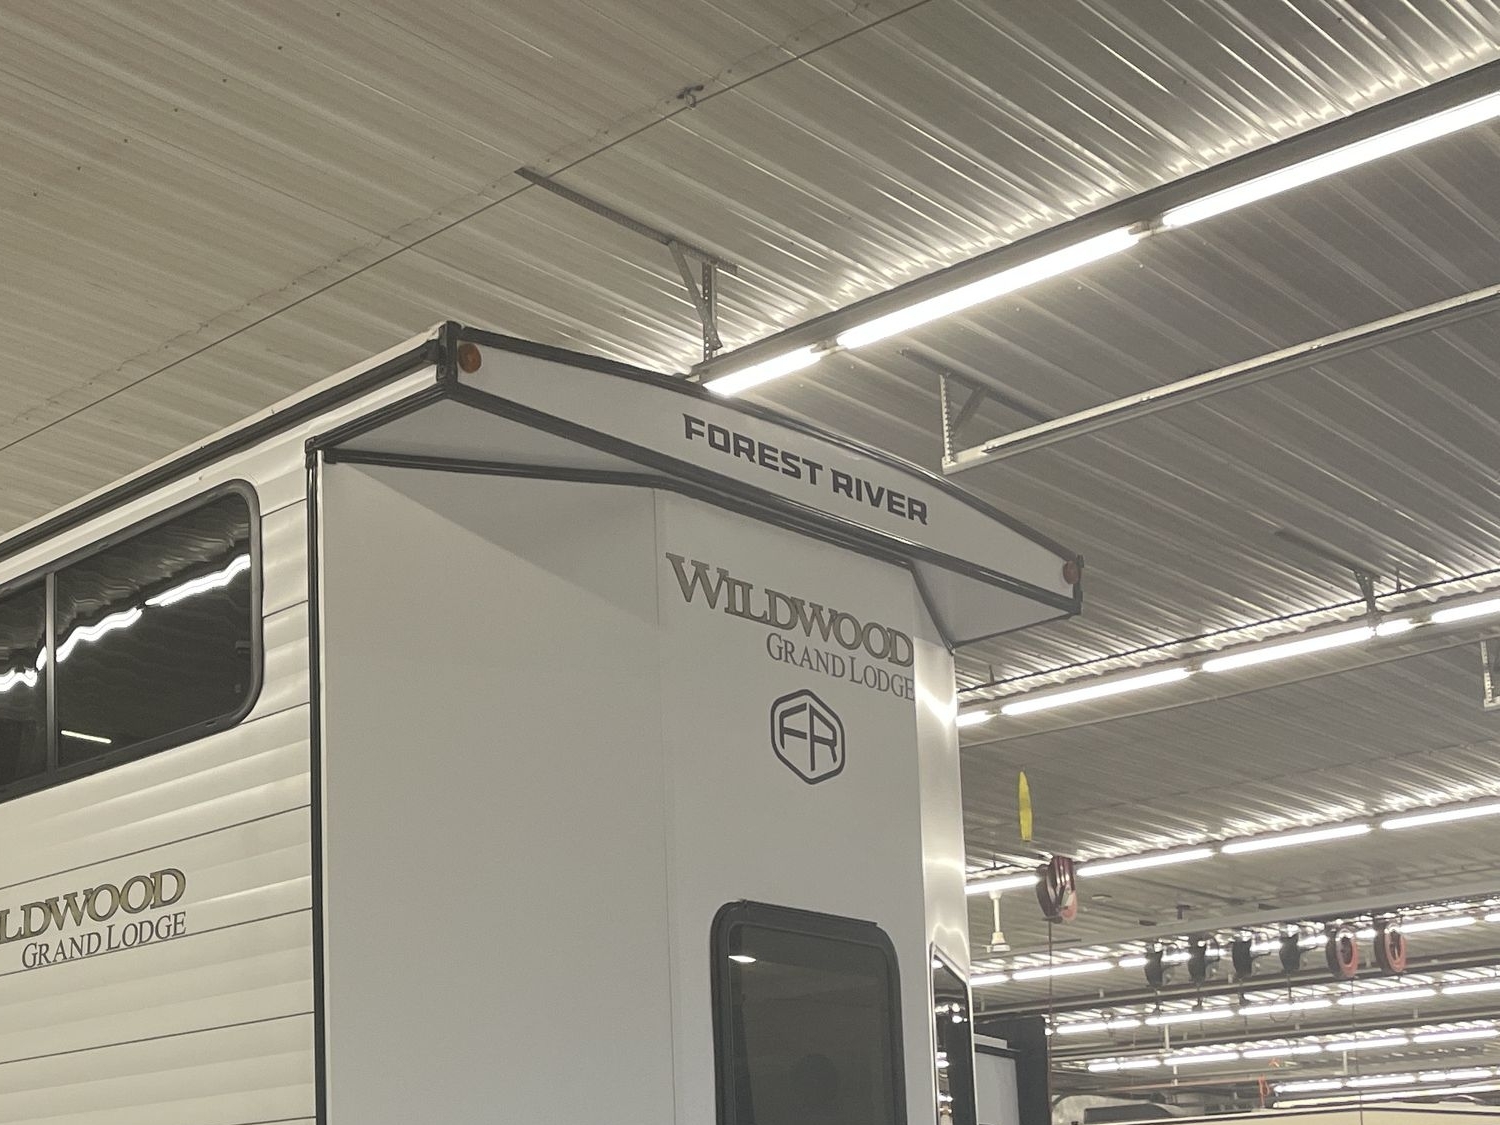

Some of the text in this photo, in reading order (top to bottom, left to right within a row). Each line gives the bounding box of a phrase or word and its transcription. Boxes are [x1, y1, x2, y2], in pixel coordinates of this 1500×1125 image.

[682, 413, 928, 526] FOREST RIVER
[666, 552, 914, 667] WILDWOOD
[766, 632, 915, 701] GRAND LODGE
[779, 702, 838, 772] FR
[21, 911, 187, 969] GRAND LODGE
